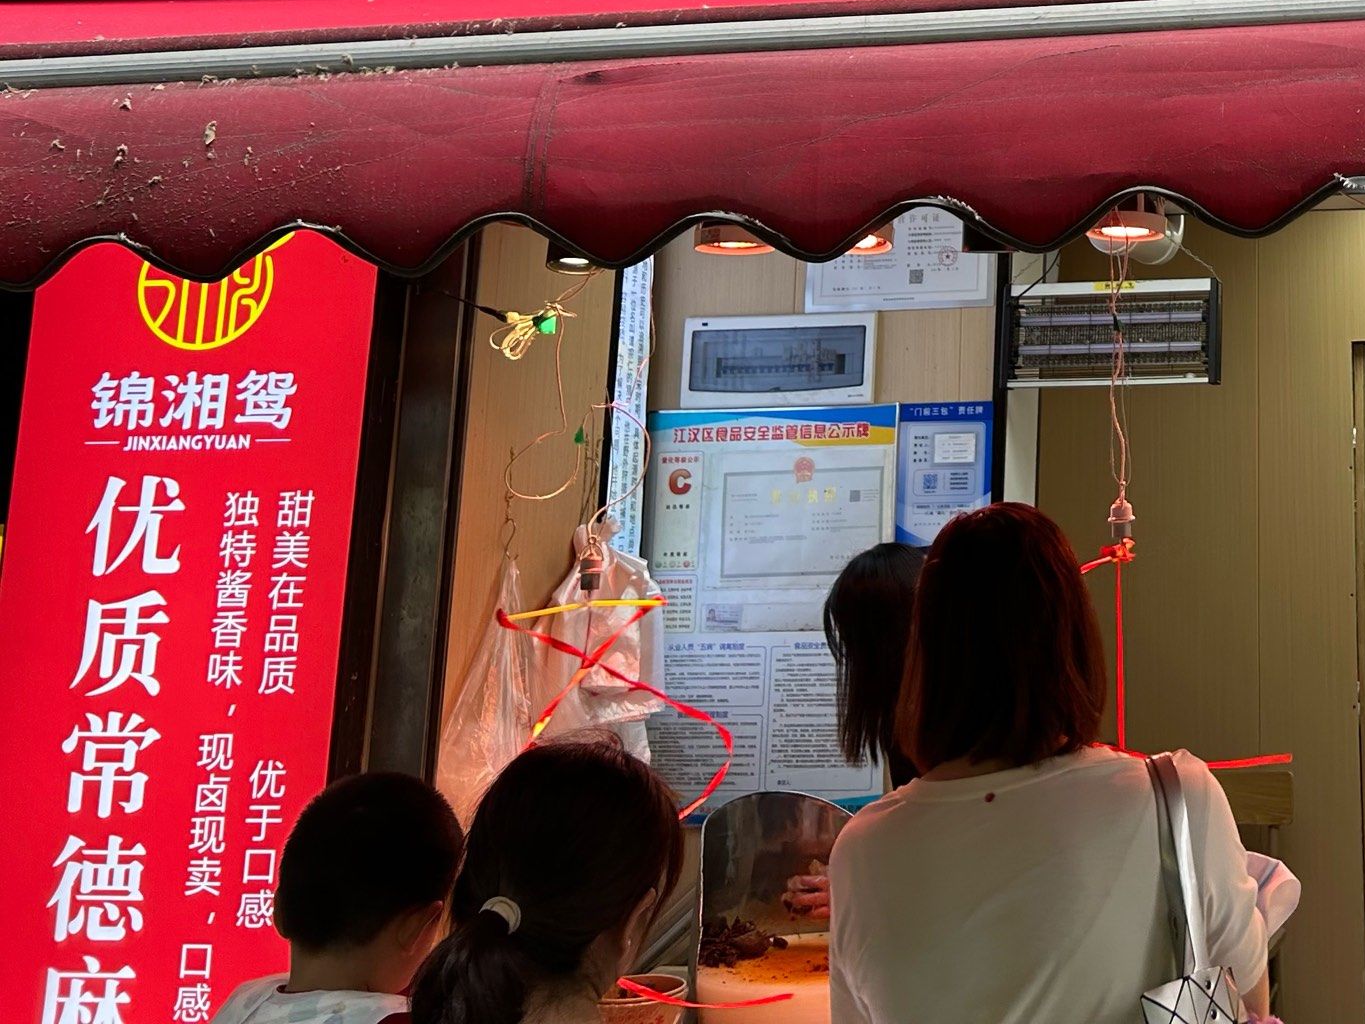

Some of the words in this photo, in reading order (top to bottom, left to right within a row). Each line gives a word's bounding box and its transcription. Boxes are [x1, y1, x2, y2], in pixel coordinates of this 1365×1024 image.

[91, 370, 297, 430] 锦湘鸳
[123, 434, 250, 451] JINXIANGYUAN
[673, 422, 871, 444] 江汉区食品安全监管信息公示牌
[668, 468, 692, 496] C
[258, 491, 315, 695] 甜美在品质
[236, 760, 287, 928] 优于口感
